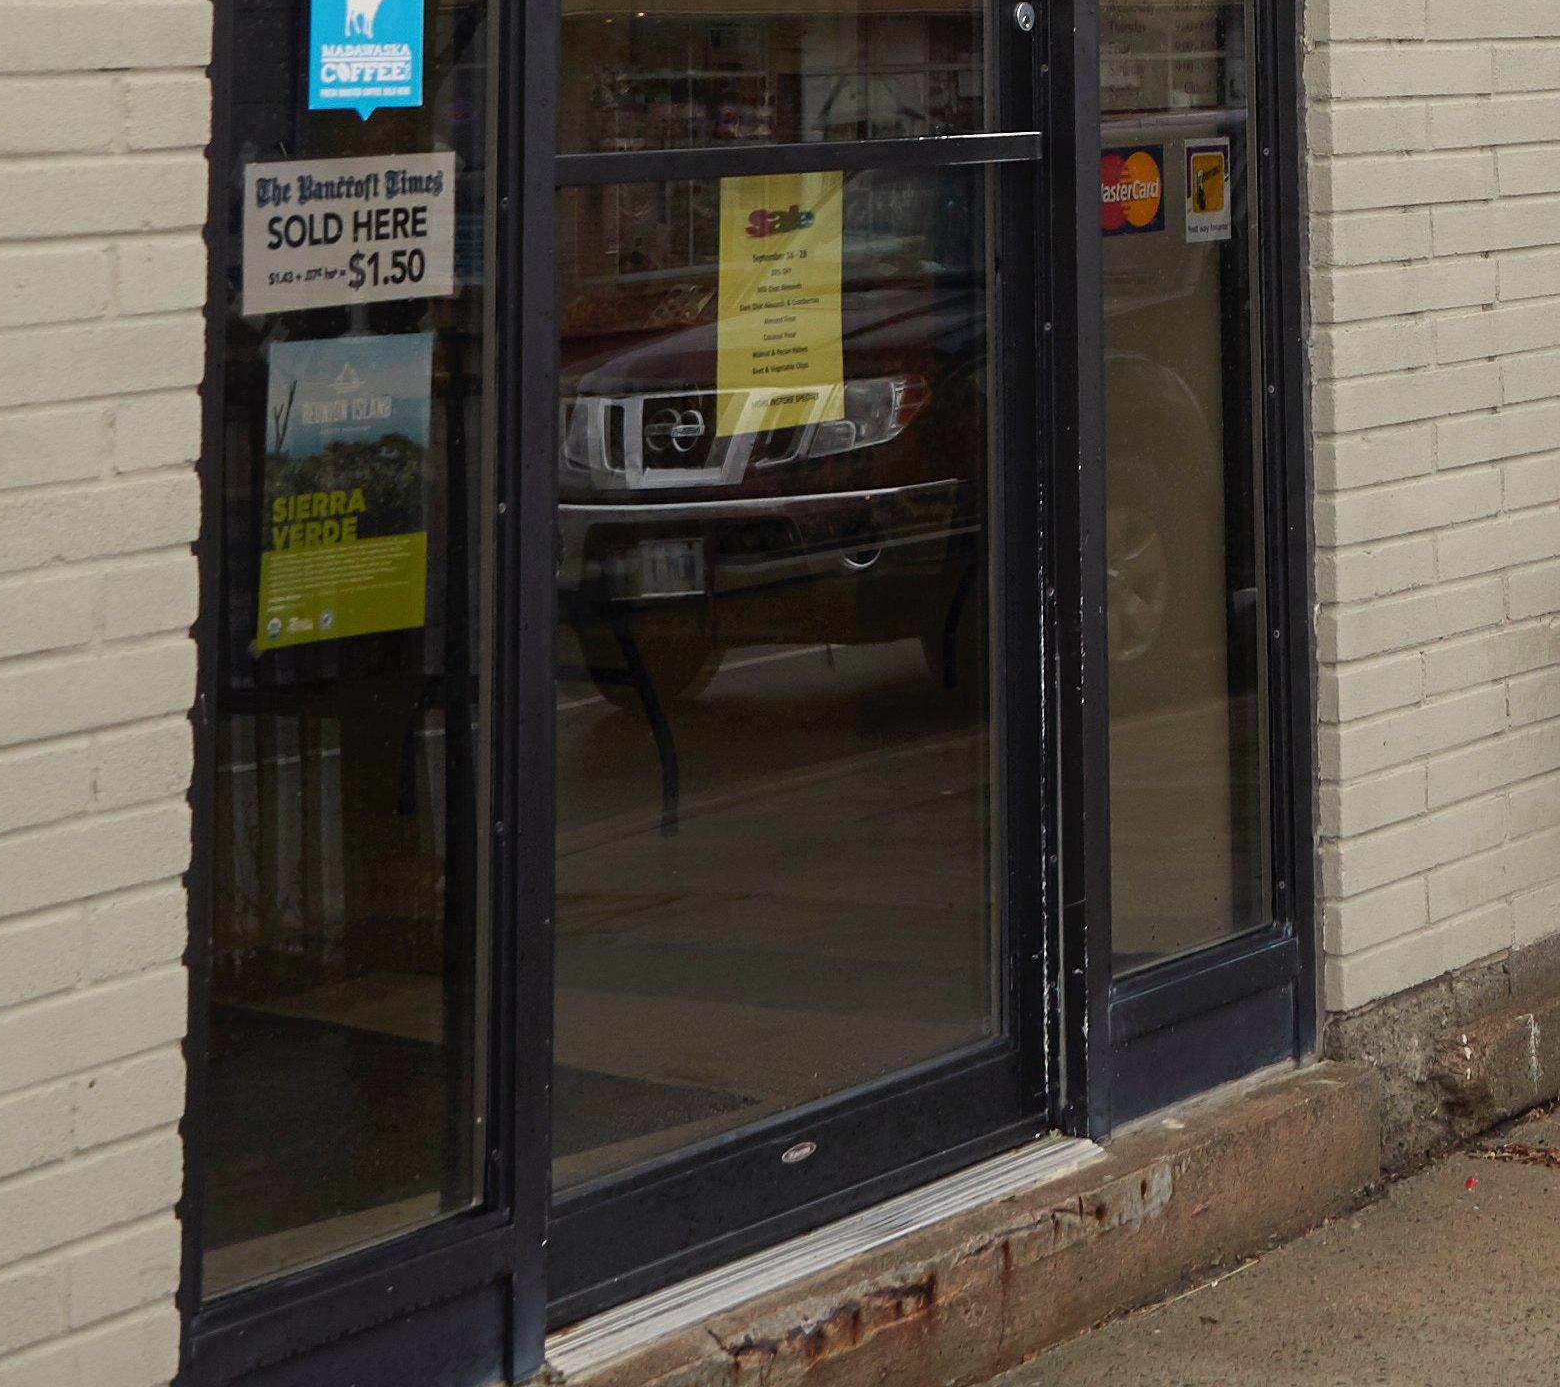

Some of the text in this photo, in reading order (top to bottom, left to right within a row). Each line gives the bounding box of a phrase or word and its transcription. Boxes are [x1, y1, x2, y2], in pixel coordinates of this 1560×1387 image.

[257, 168, 444, 208] The Bancroft Times
[1100, 178, 1160, 203] asterCard
[267, 205, 428, 250] SOLD HERE
[744, 203, 815, 239] sale
[348, 248, 426, 291] $1.50
[271, 487, 369, 523] SIERRA
[271, 517, 359, 552] VERDE
